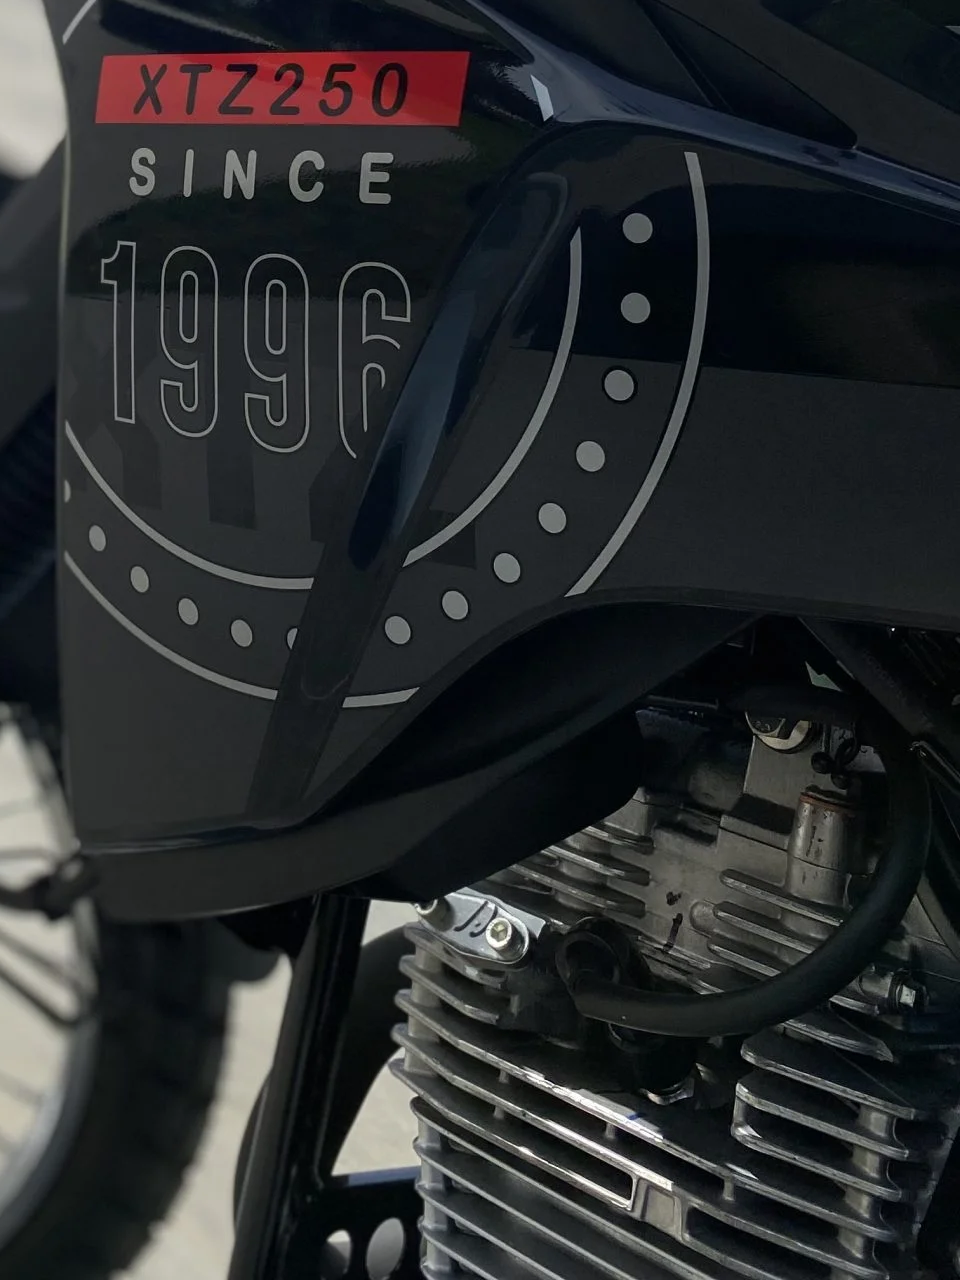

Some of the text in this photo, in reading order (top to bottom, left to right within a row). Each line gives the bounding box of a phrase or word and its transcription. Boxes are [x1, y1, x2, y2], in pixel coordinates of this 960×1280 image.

[133, 63, 409, 117] XTZ250
[129, 147, 394, 204] SINCE
[101, 240, 411, 458] 1996
